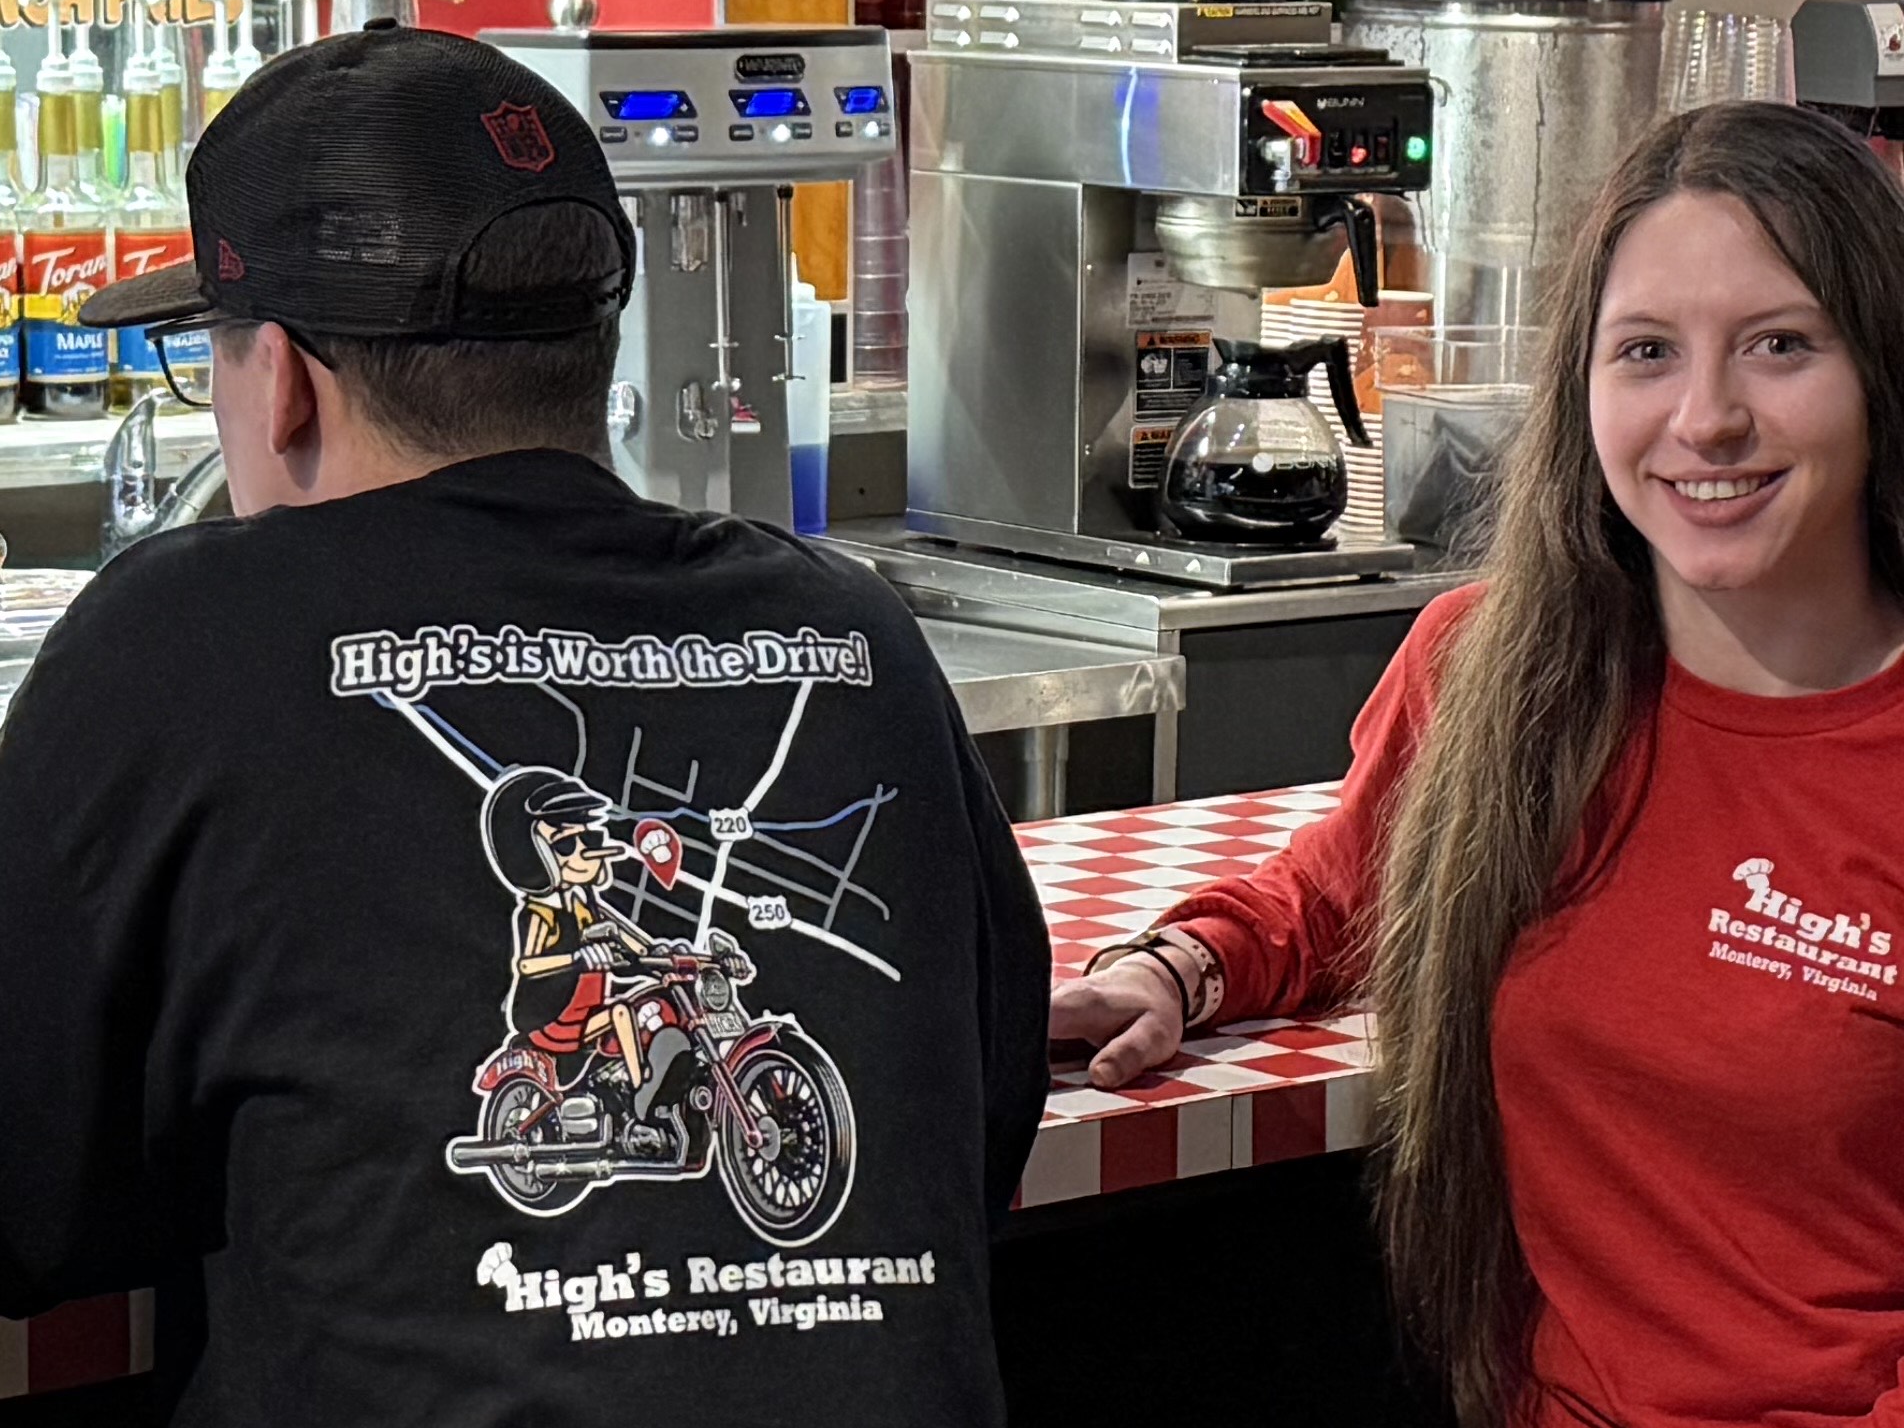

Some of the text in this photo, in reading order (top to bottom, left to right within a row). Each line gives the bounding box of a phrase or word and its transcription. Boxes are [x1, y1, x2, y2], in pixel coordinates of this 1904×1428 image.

[341, 632, 868, 693] High's is Worth the Drive!
[714, 816, 747, 833] 220
[752, 903, 785, 921] 250
[1745, 887, 1892, 956] High's
[1708, 907, 1898, 985] Restaurant
[1709, 941, 1878, 1001] Monterey, Virginia
[504, 1249, 936, 1314] High's Restaurant
[570, 1294, 883, 1341] Monterey, Virginia
